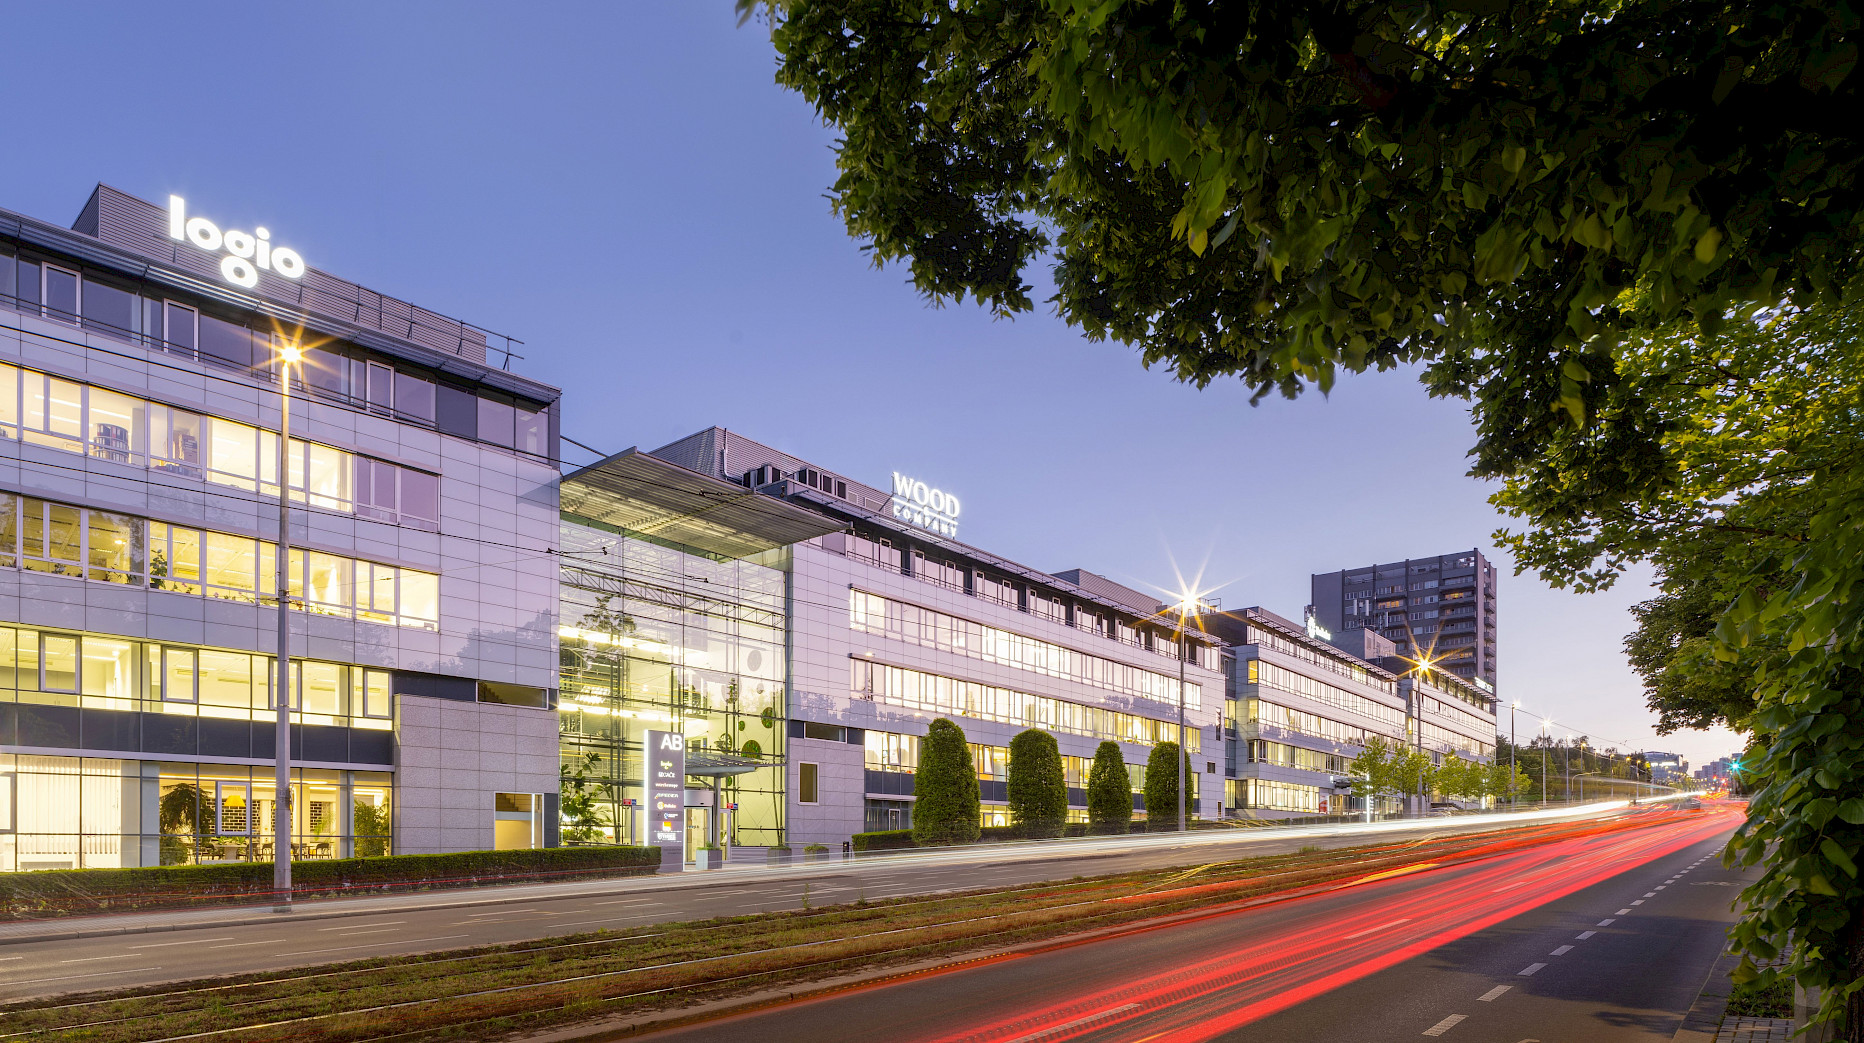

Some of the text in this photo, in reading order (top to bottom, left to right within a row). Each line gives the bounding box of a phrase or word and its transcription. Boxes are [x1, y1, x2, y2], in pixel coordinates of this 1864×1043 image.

[169, 194, 305, 289] logio
[893, 471, 960, 518] WOOD
[893, 504, 957, 537] COMPANY
[660, 734, 683, 751] AB
